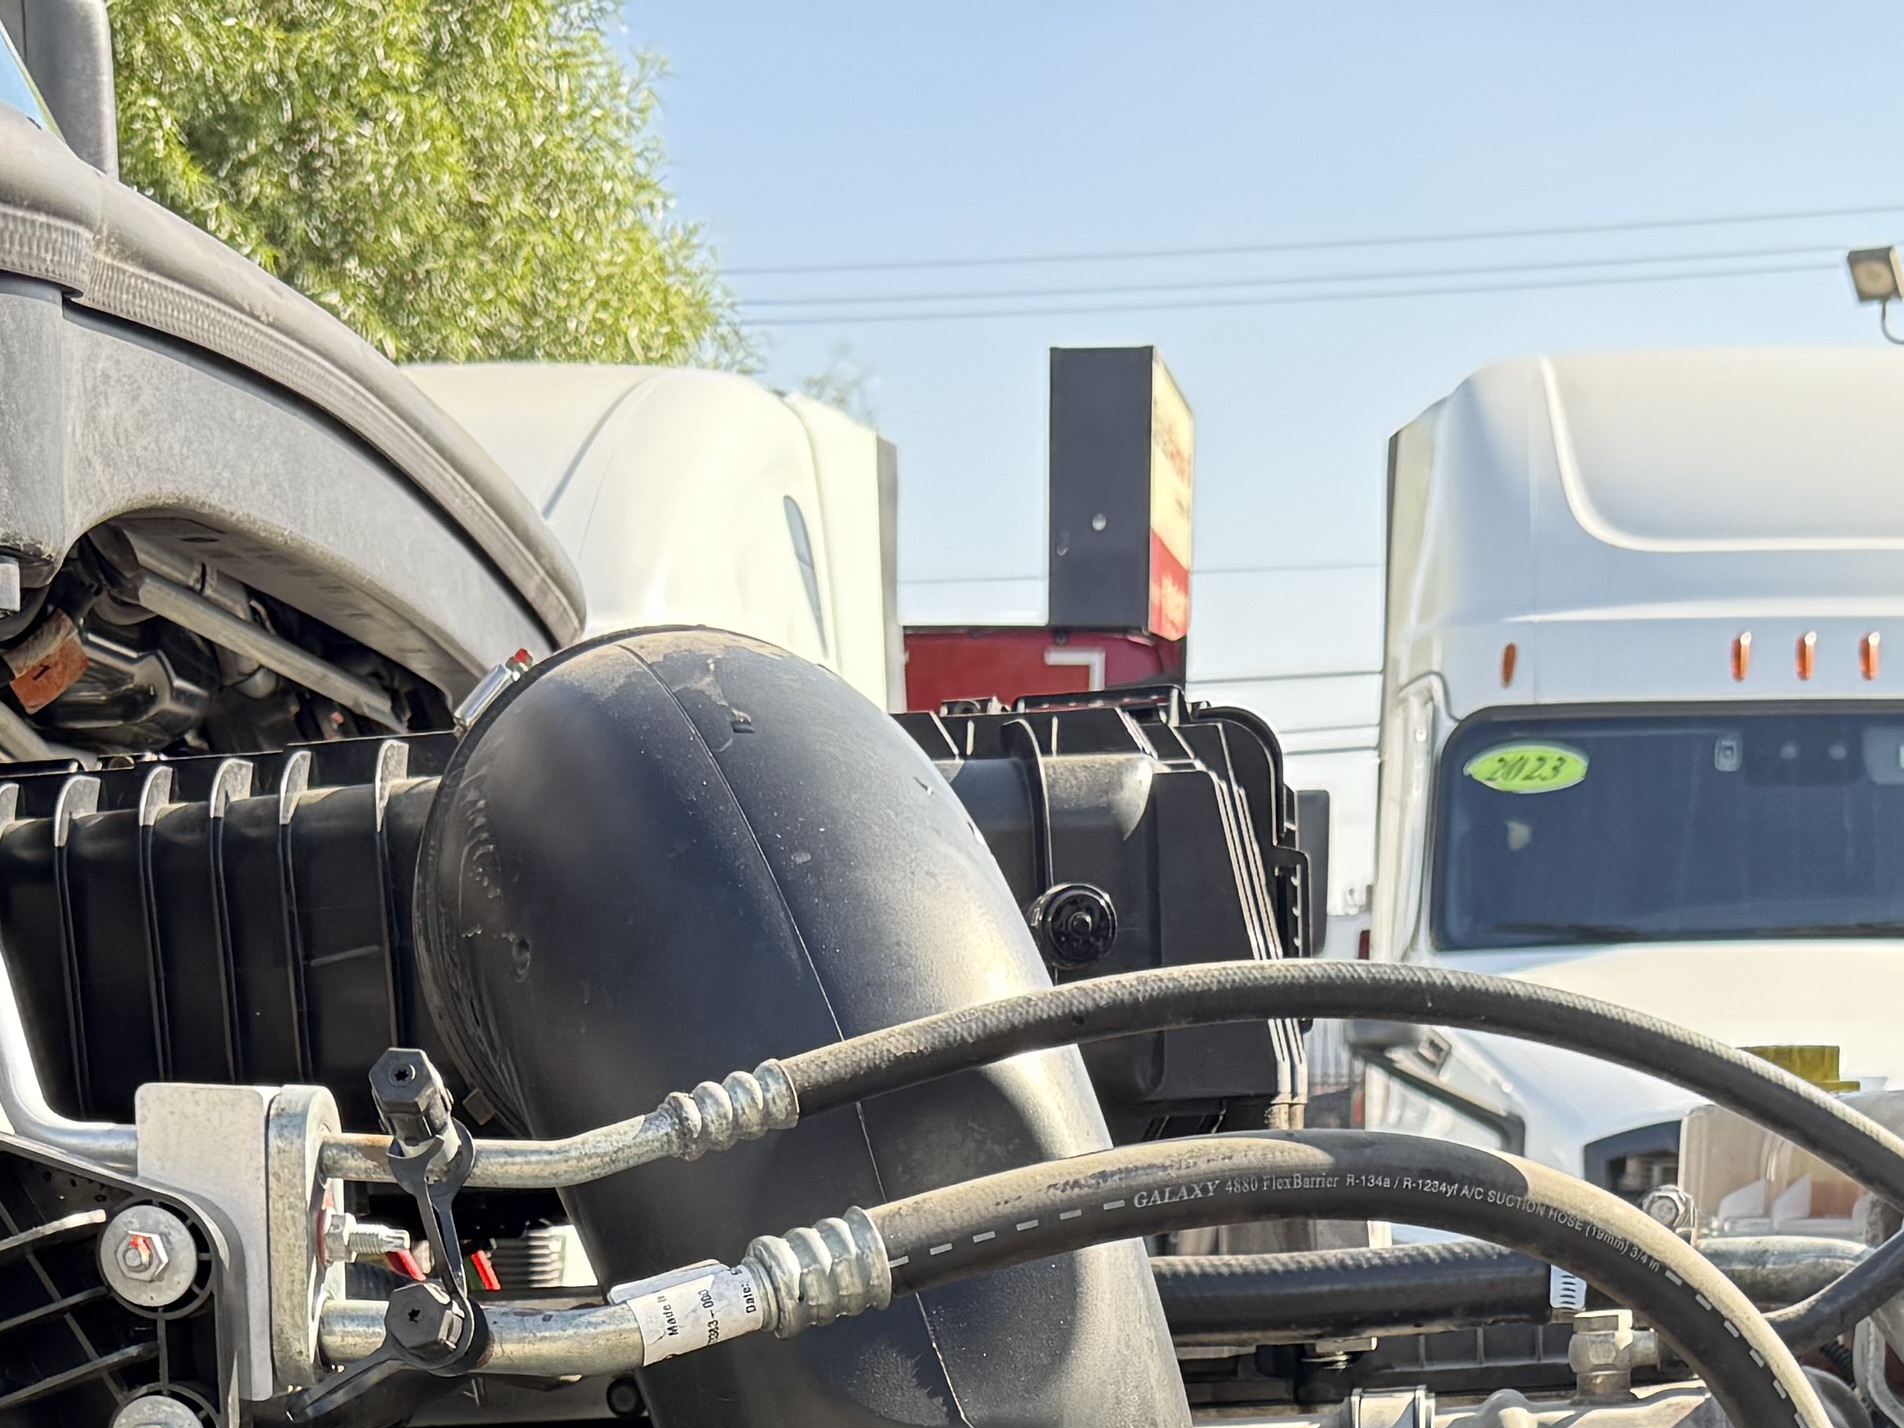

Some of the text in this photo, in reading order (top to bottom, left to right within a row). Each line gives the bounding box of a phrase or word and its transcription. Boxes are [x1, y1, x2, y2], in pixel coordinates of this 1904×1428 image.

[1485, 756, 1567, 781] 2023
[1133, 1179, 1221, 1209] GALAXY
[1225, 1175, 1258, 1195] 4880
[1262, 1172, 1339, 1190] FlexBarrier
[1346, 1173, 1391, 1188] R-134a
[1402, 1177, 1459, 1197] R-1234yf
[1460, 1185, 1484, 1200] A/C
[1487, 1189, 1545, 1218] SUCTION
[1547, 1206, 1584, 1233] HOSE
[1630, 1246, 1648, 1265] 3/4
